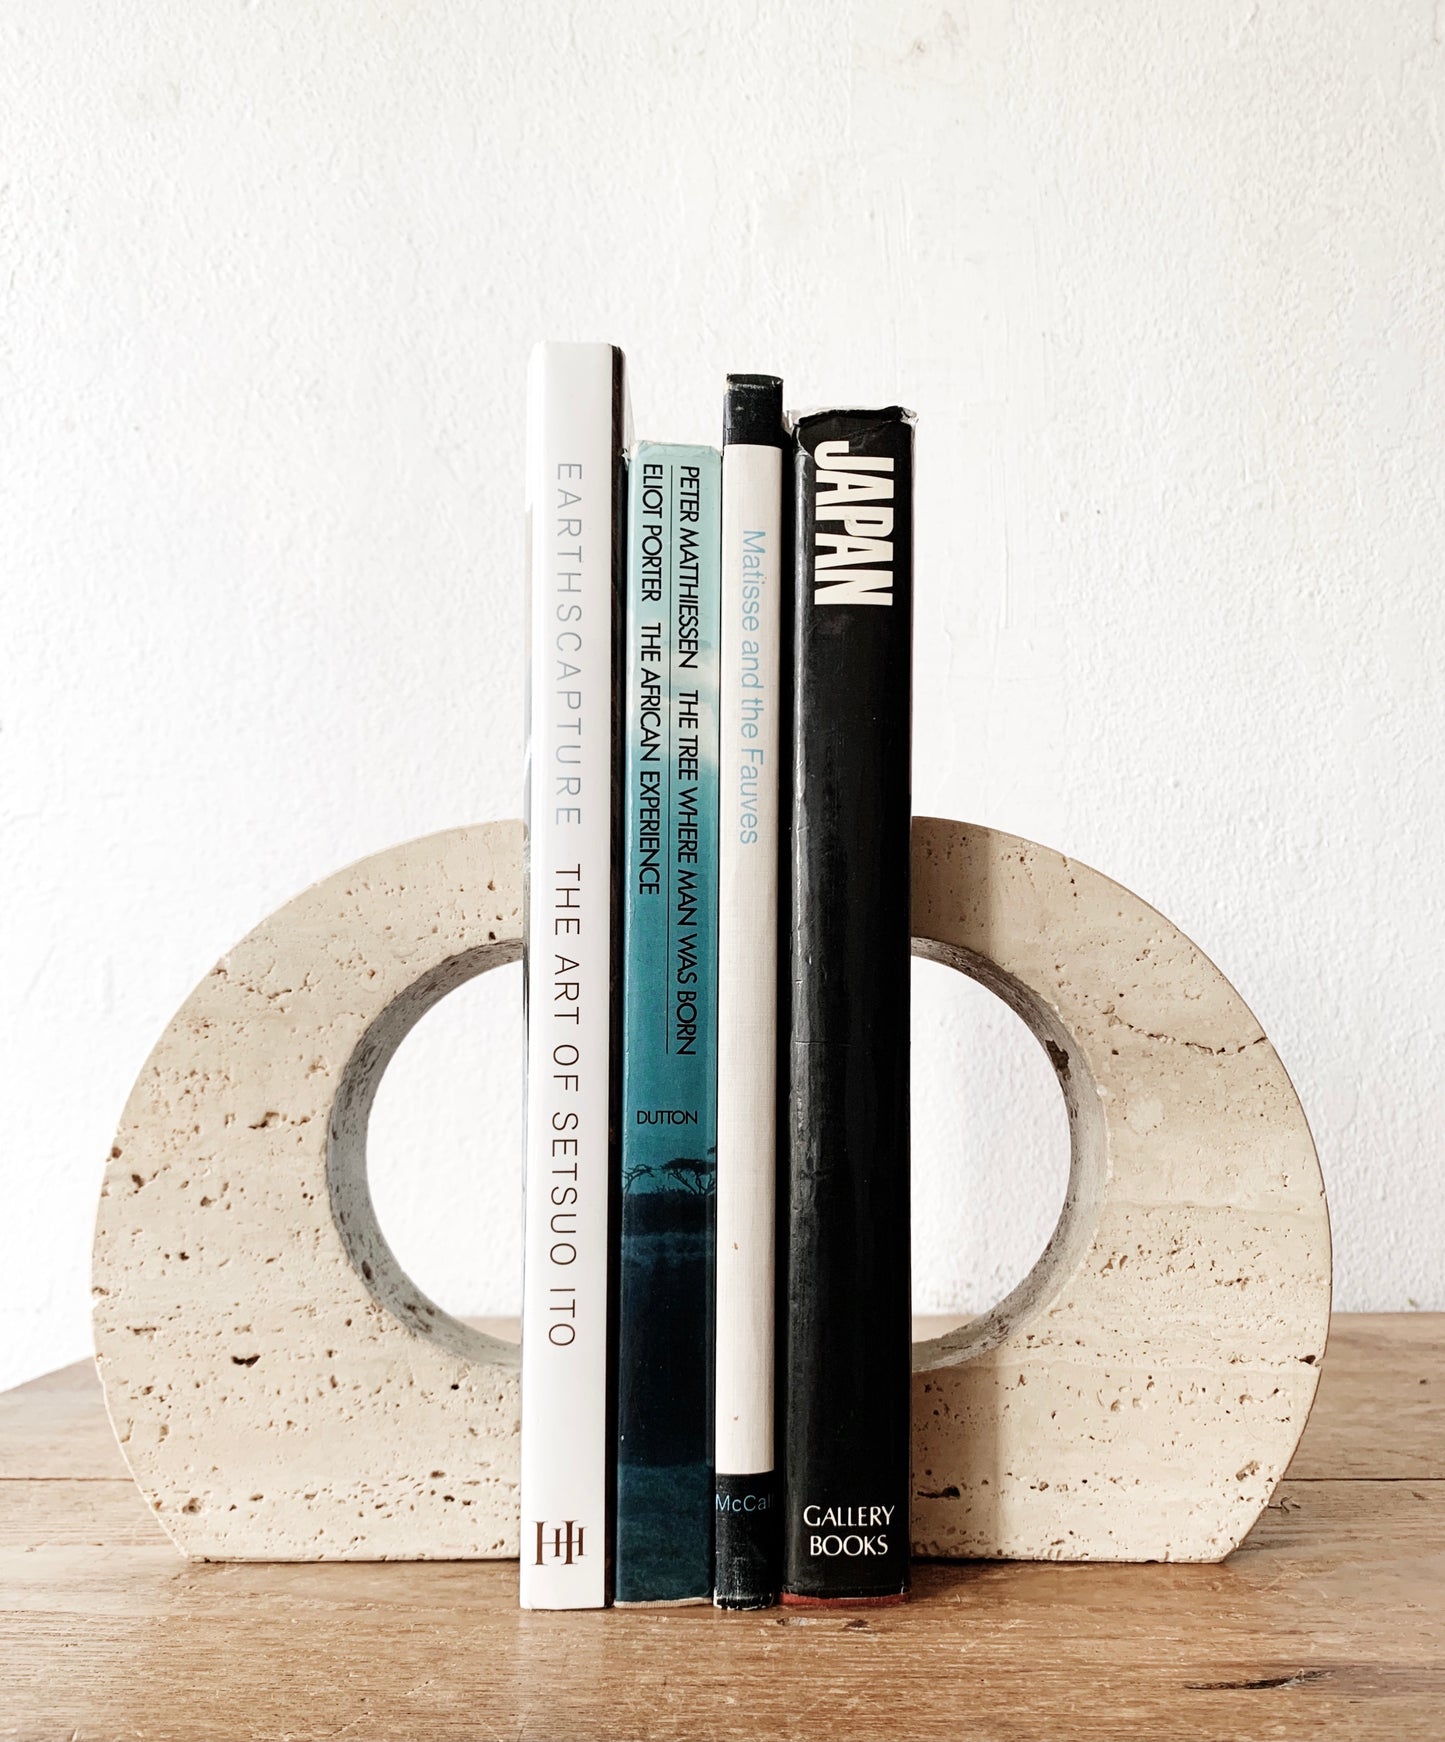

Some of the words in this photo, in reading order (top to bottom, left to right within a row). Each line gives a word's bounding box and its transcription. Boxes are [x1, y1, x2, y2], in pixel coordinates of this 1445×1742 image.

[642, 463, 664, 519] ELIOT
[679, 465, 700, 522] PETER
[814, 440, 895, 606] JAPAN
[641, 525, 663, 602] PORTER
[741, 529, 767, 632] Matisse
[678, 527, 700, 669] MATTHIESSEN
[555, 463, 583, 825] EARTHSCAPTURE
[640, 622, 662, 663] THE
[741, 639, 765, 689] and
[640, 667, 662, 761] AFRICAN
[678, 689, 699, 729] THE
[740, 697, 765, 739] the
[678, 735, 699, 781] TREE
[677, 787, 699, 864] WHERE
[739, 748, 764, 845] Fauves
[639, 771, 661, 895] EXPERIENCE
[555, 863, 581, 936] THE
[677, 869, 698, 926] MAN
[677, 933, 698, 985] WAS
[554, 954, 580, 1025] ART
[676, 991, 698, 1056] BORN
[552, 1044, 579, 1092] OF
[636, 1110, 698, 1125] DUTTON
[550, 1112, 579, 1266] SETSUO
[548, 1288, 576, 1346] ITO
[803, 1504, 895, 1528] GALLERY
[810, 1534, 889, 1557] BOOKS
